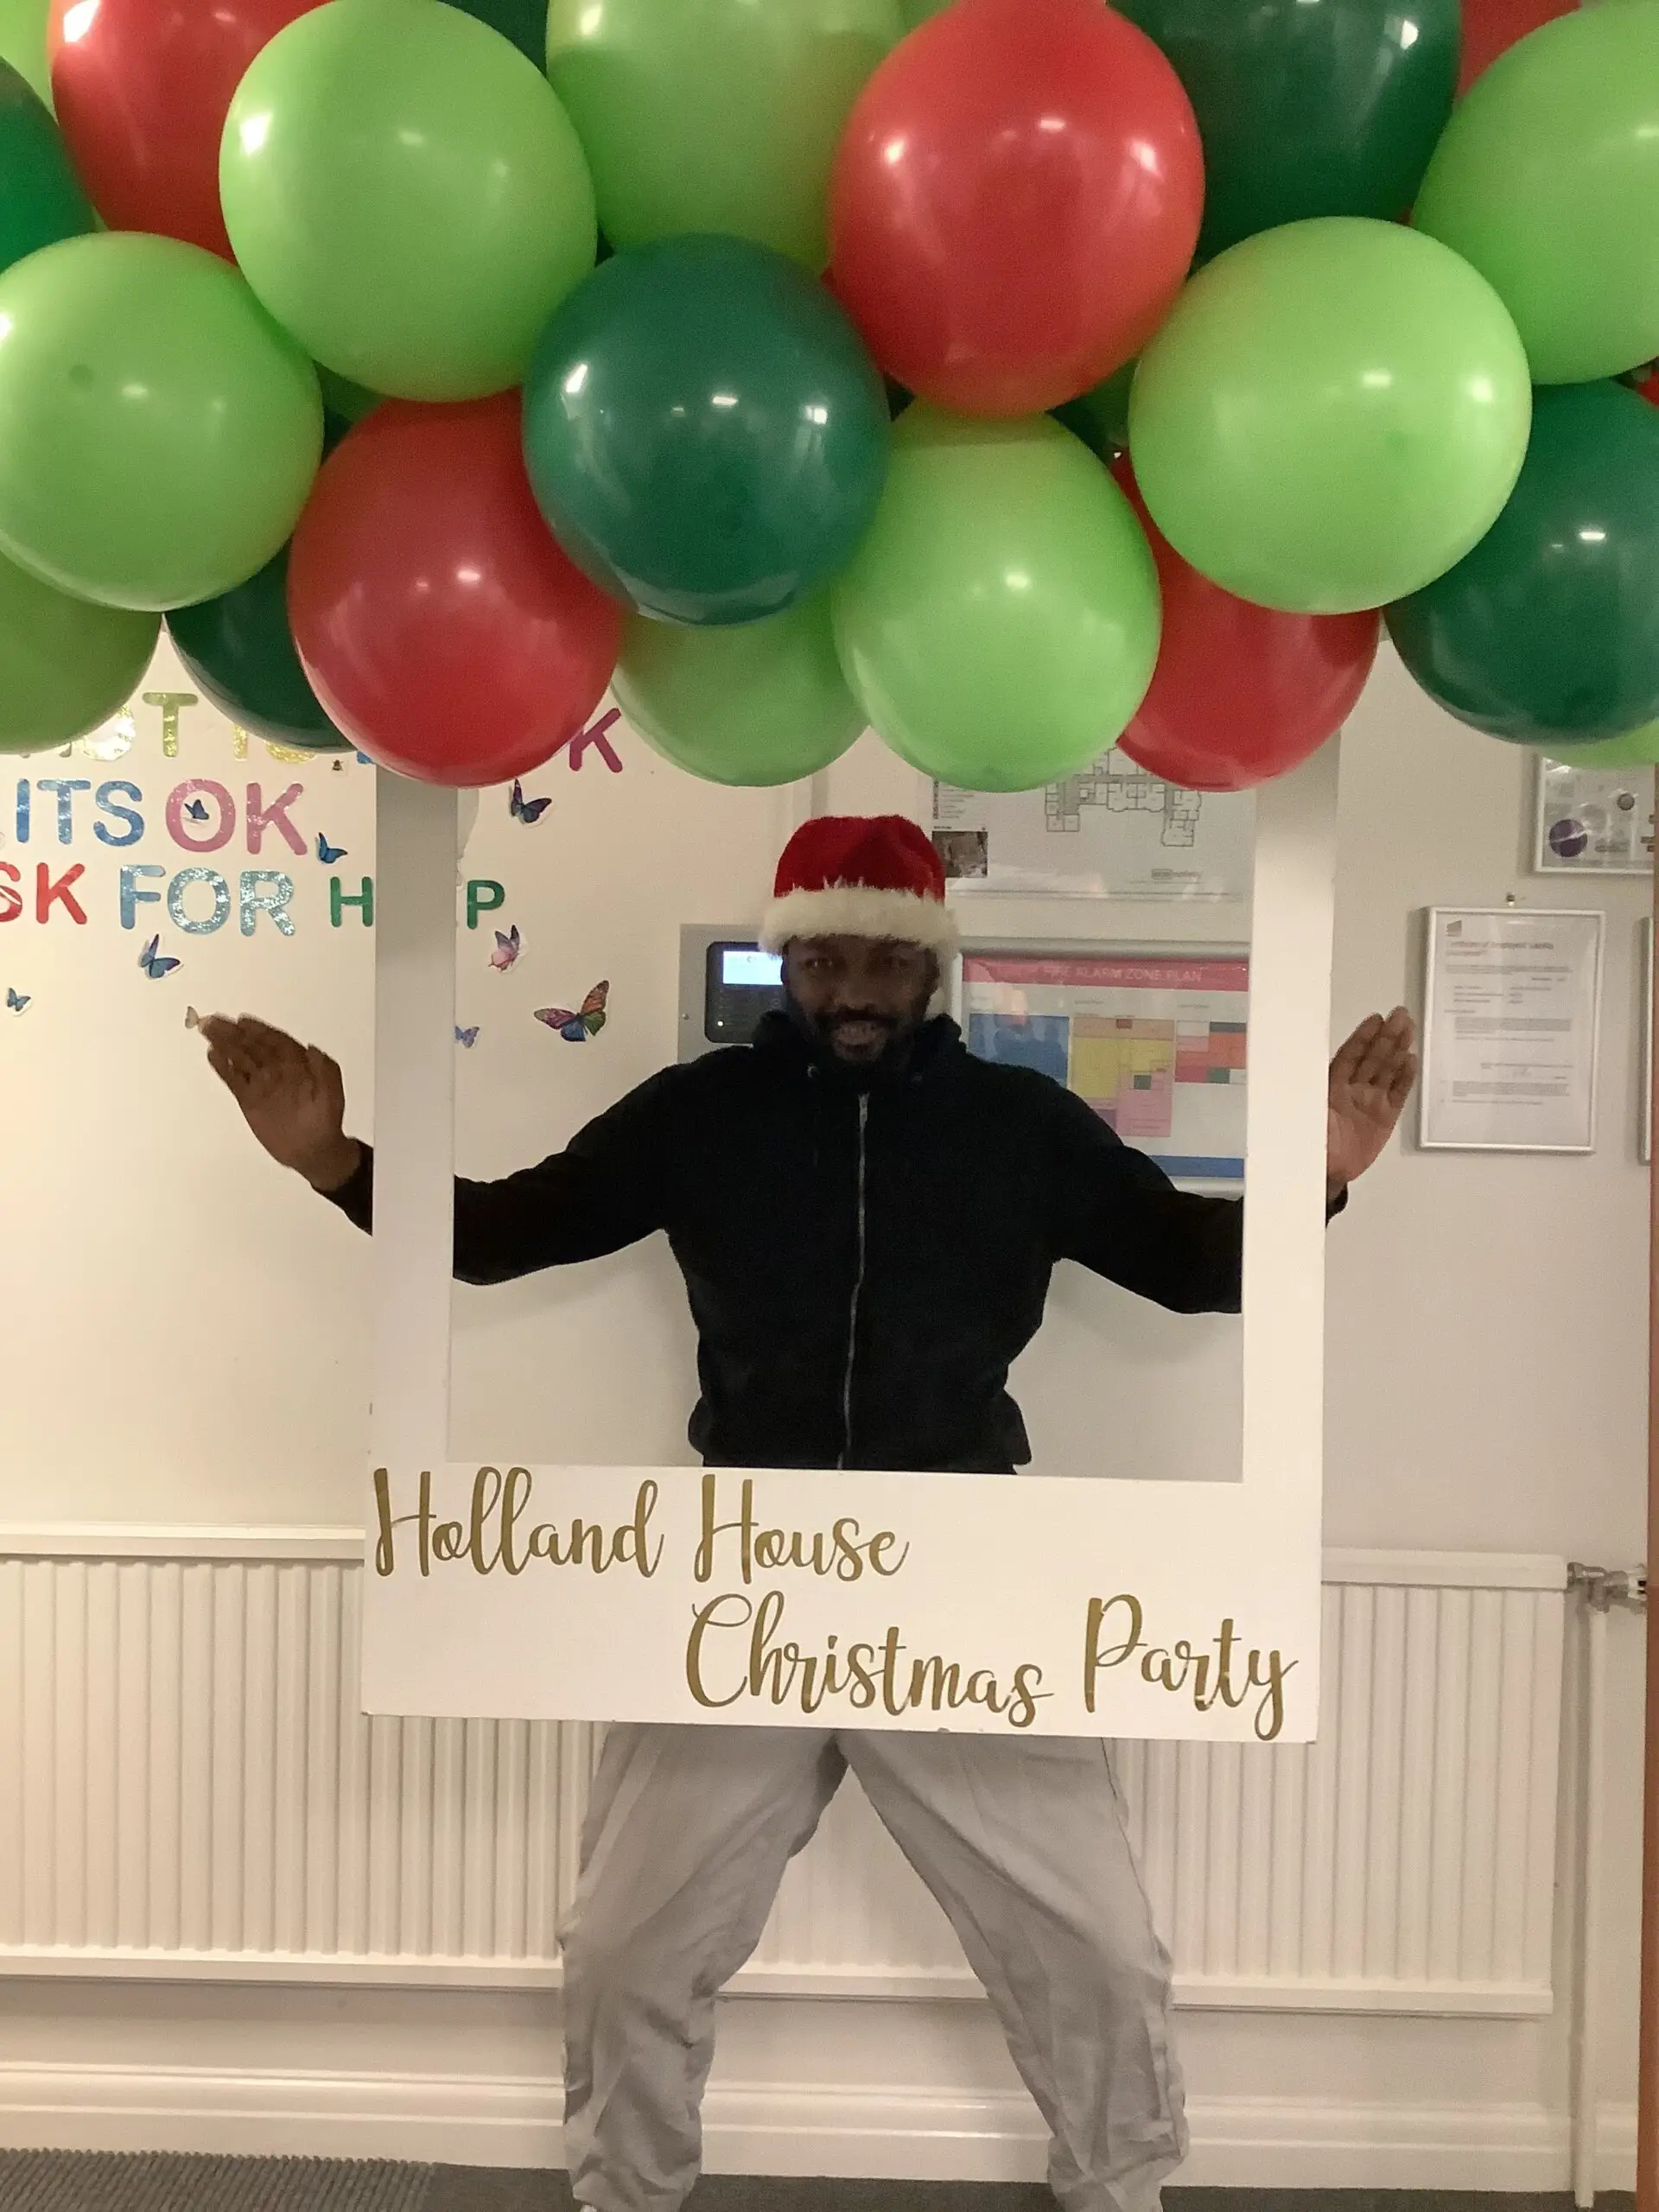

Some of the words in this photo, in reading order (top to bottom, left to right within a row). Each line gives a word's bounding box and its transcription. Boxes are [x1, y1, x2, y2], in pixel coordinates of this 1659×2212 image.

[16, 779, 145, 847] ITS
[165, 779, 308, 855] OK
[119, 864, 295, 937] FOR
[330, 875, 506, 930] HP
[1125, 969, 1161, 982] ZONE
[1166, 969, 1202, 982] PLAN
[373, 1467, 664, 1578] Holland
[693, 1473, 909, 1584] House
[686, 1590, 1054, 1728] Christmas
[1085, 1593, 1299, 1741] Party
